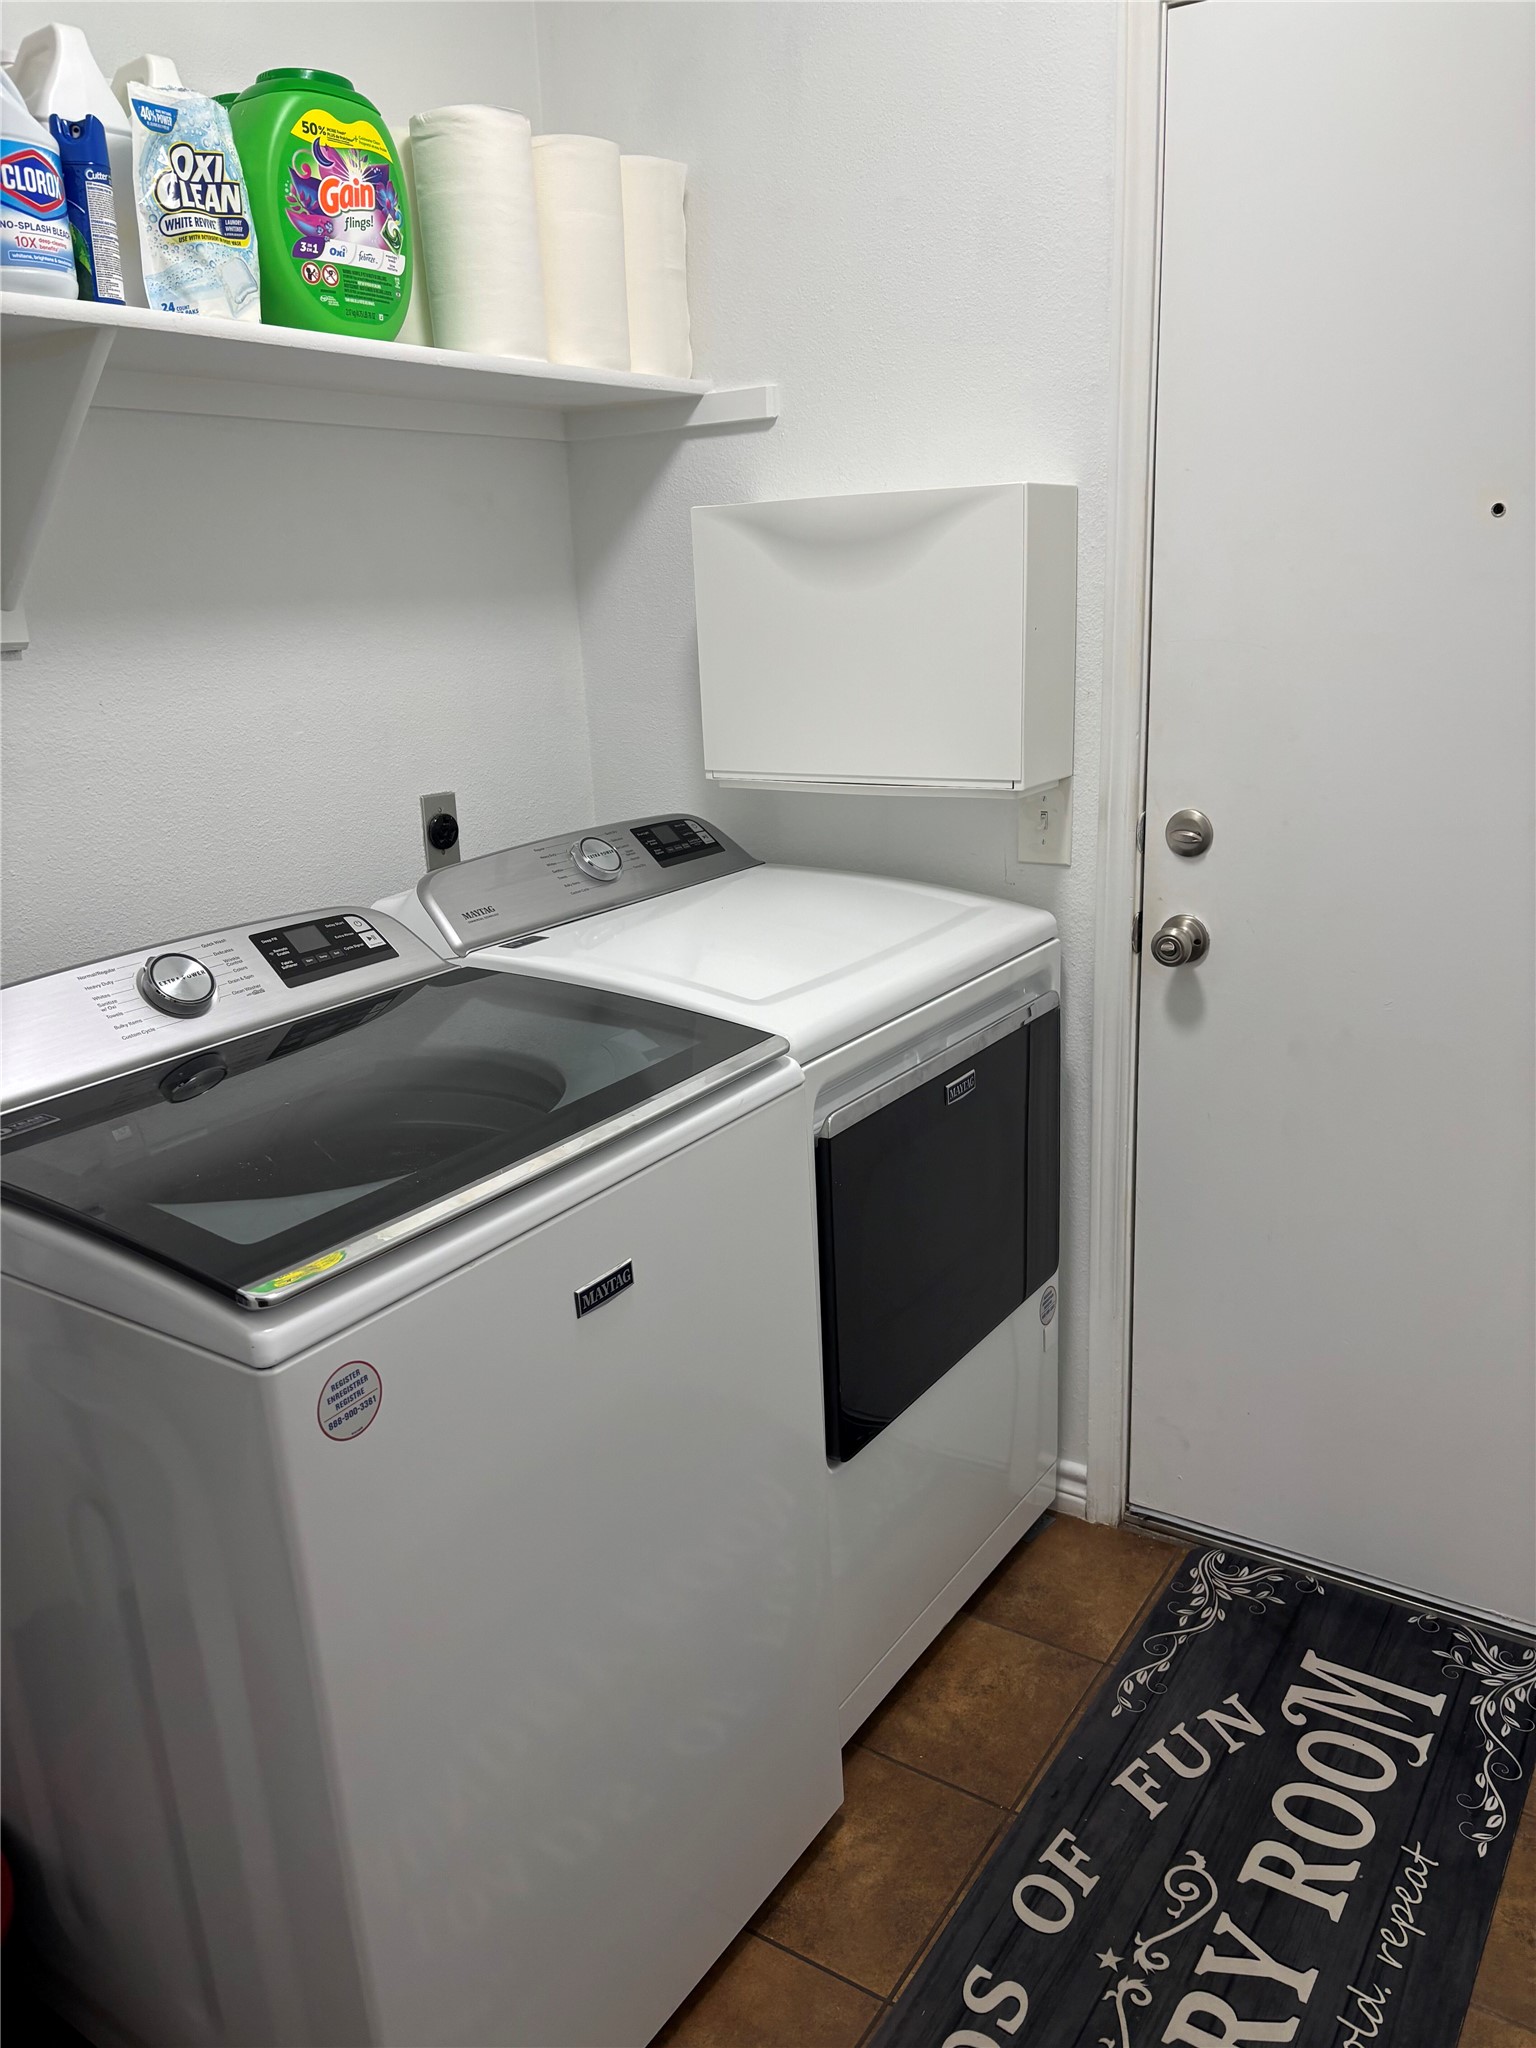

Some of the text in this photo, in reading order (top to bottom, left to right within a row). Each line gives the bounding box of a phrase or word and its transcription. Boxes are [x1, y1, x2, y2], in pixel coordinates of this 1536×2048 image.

[302, 121, 326, 136] 50%
[171, 144, 223, 182] OXI
[1, 164, 62, 200] CLOROX
[85, 170, 107, 181] Cutter
[157, 172, 240, 213] CLEAN
[320, 178, 373, 214] Gain
[0, 220, 51, 234] NO-SPLASH
[165, 216, 193, 231] WHITE
[344, 216, 373, 231] flings!
[15, 236, 37, 248] 10X
[300, 242, 306, 252] 3
[312, 244, 318, 254] 1
[330, 248, 346, 258] Oxi
[161, 302, 175, 312] 24
[461, 906, 495, 920] MAYTAG
[77, 968, 116, 980] Normal/Regular
[950, 1075, 974, 1100] MAYTAG
[582, 1268, 631, 1310] MAYTAG
[327, 1374, 368, 1405] ENREGISTRER
[330, 1368, 360, 1392] REGISTER
[335, 1387, 365, 1411] REGISTRE
[328, 1395, 377, 1431] 888-900-3381
[1237, 1648, 1447, 1923] ROOM
[941, 1692, 1266, 2048] S OF FUN
[1376, 1841, 1439, 1969] repeat
